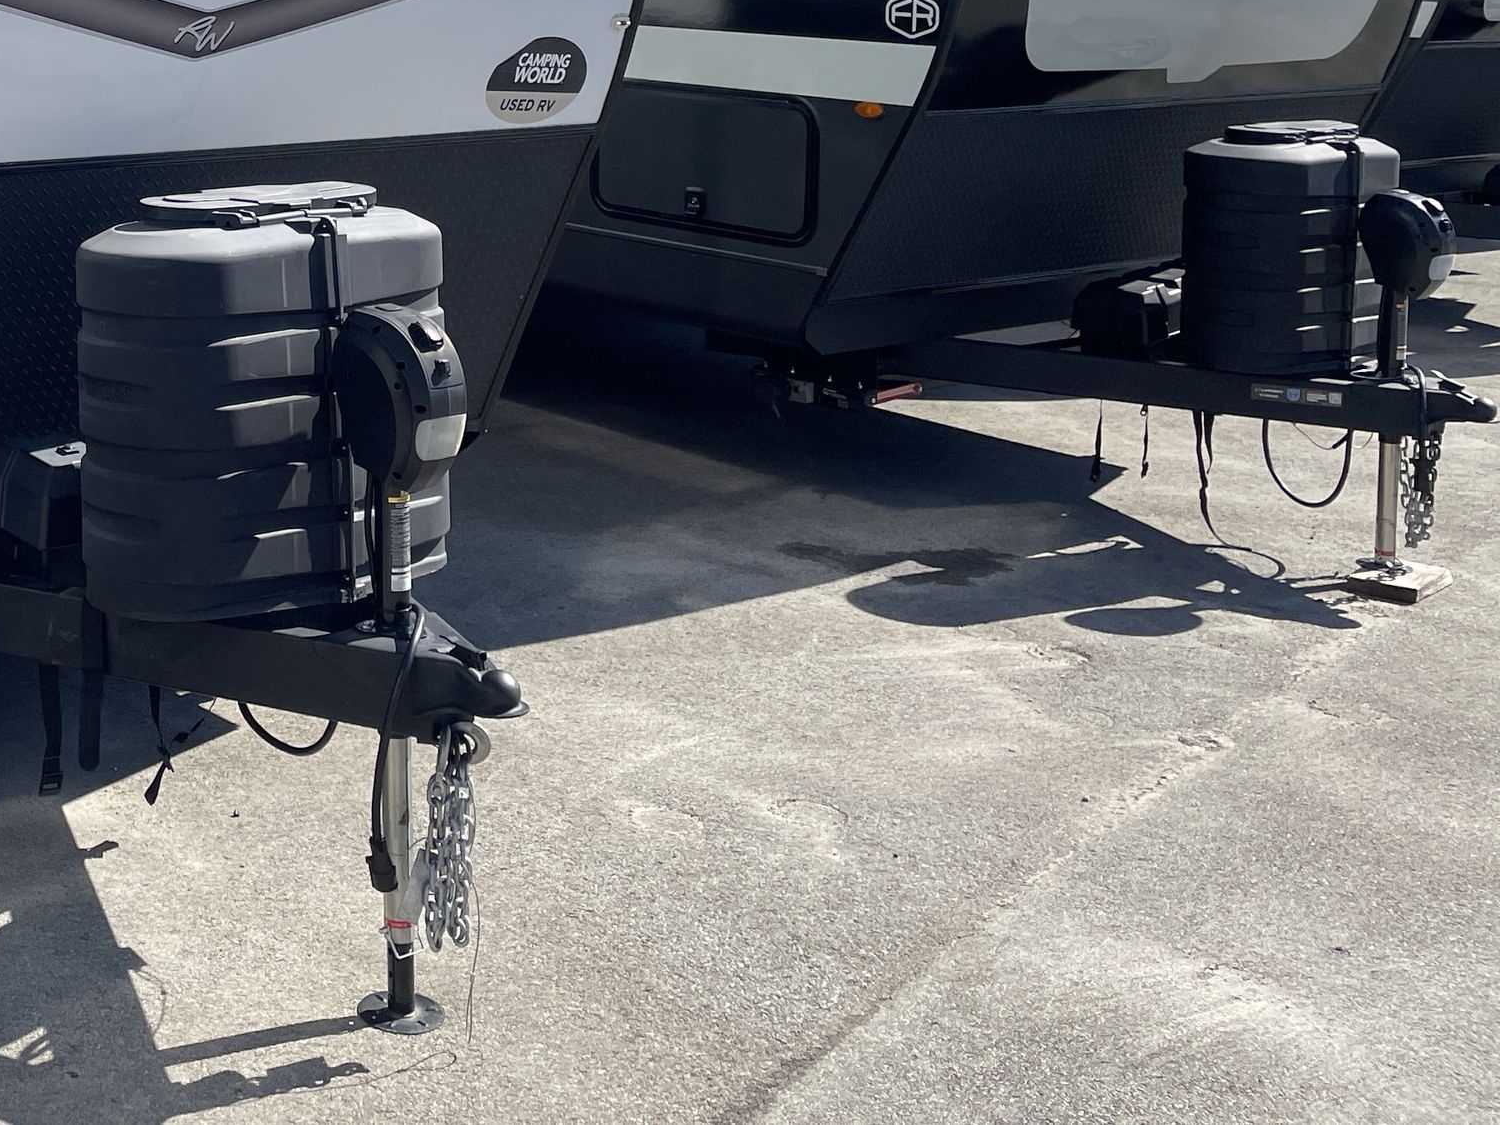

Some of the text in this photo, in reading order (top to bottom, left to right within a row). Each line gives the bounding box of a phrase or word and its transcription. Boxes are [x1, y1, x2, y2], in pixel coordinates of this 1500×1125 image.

[518, 52, 572, 69] CAMPING
[514, 66, 567, 85] WORLD
[500, 98, 556, 112] USED RV
